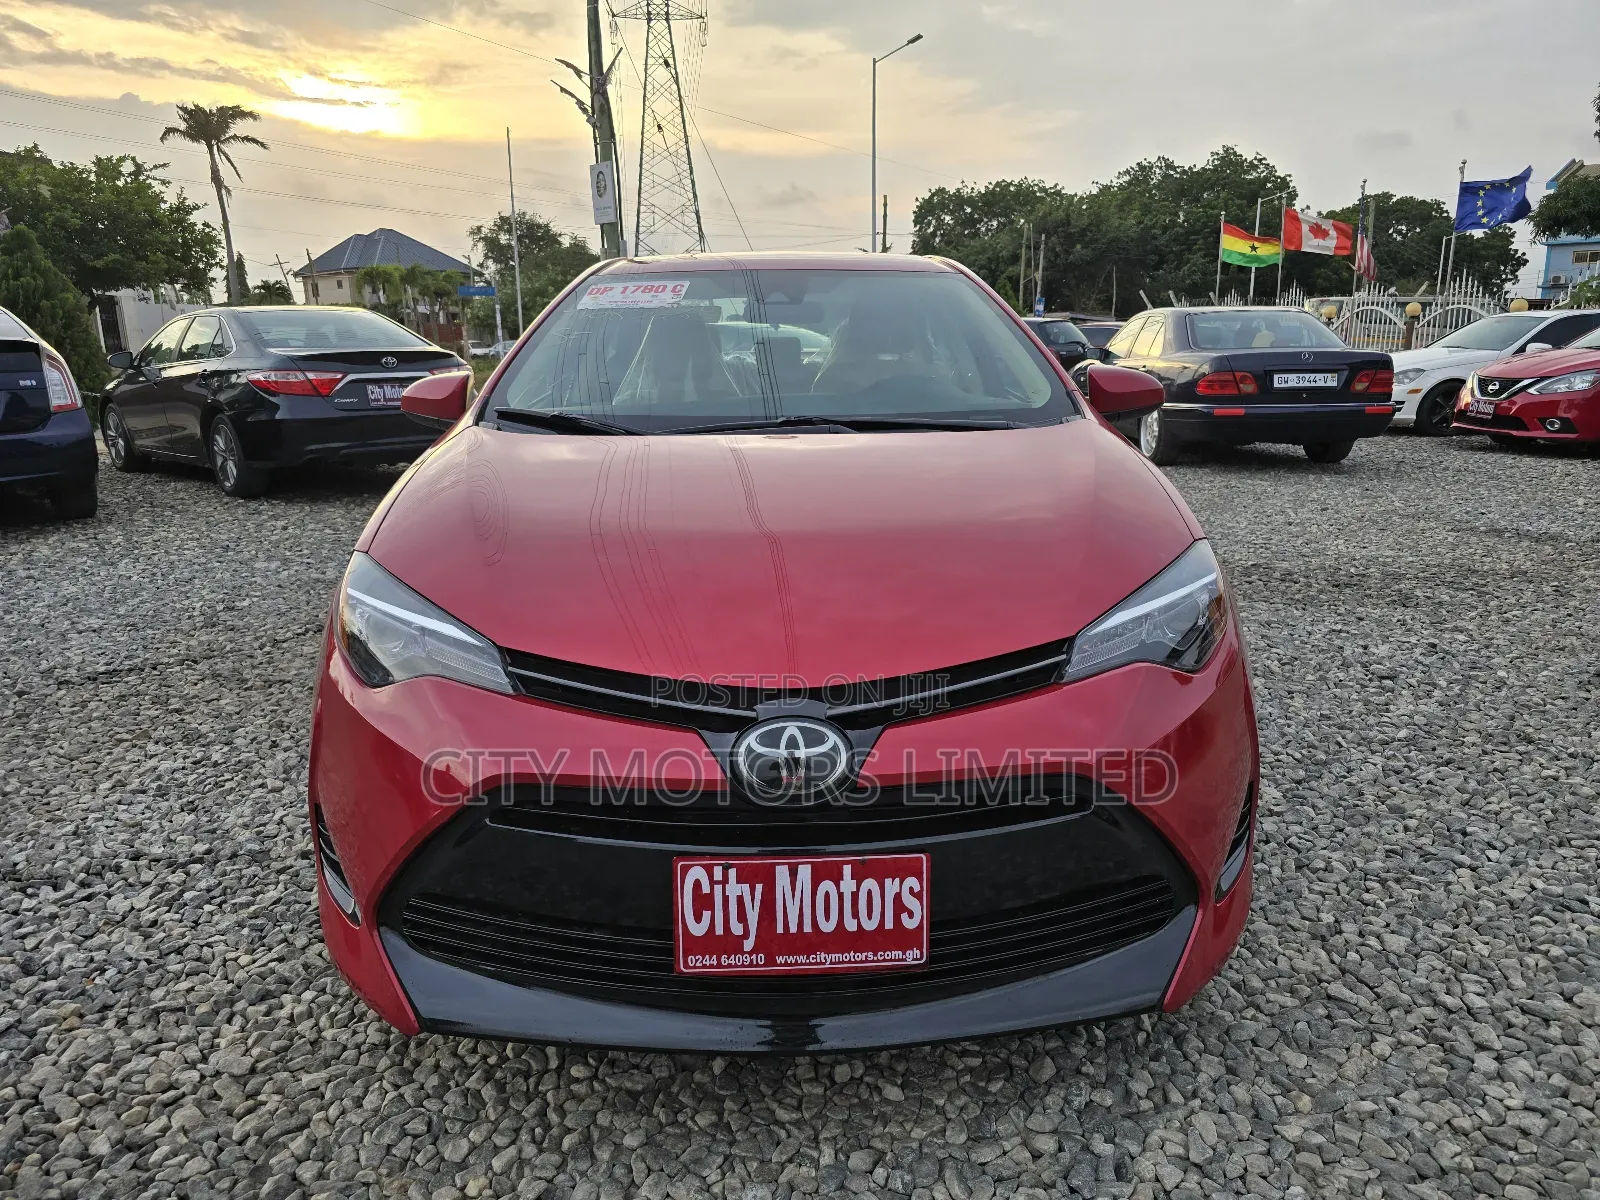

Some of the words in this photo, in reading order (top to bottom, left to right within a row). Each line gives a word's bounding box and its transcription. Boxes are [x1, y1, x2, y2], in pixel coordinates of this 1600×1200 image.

[587, 286, 615, 296] DP
[620, 284, 668, 294] 1780
[671, 283, 685, 294] C
[368, 384, 384, 402] City
[683, 864, 763, 952] City
[775, 863, 922, 934] Motors
[688, 955, 718, 967] 0244
[720, 953, 765, 966] 640910
[775, 948, 921, 965] www.citymotors.com.gh
